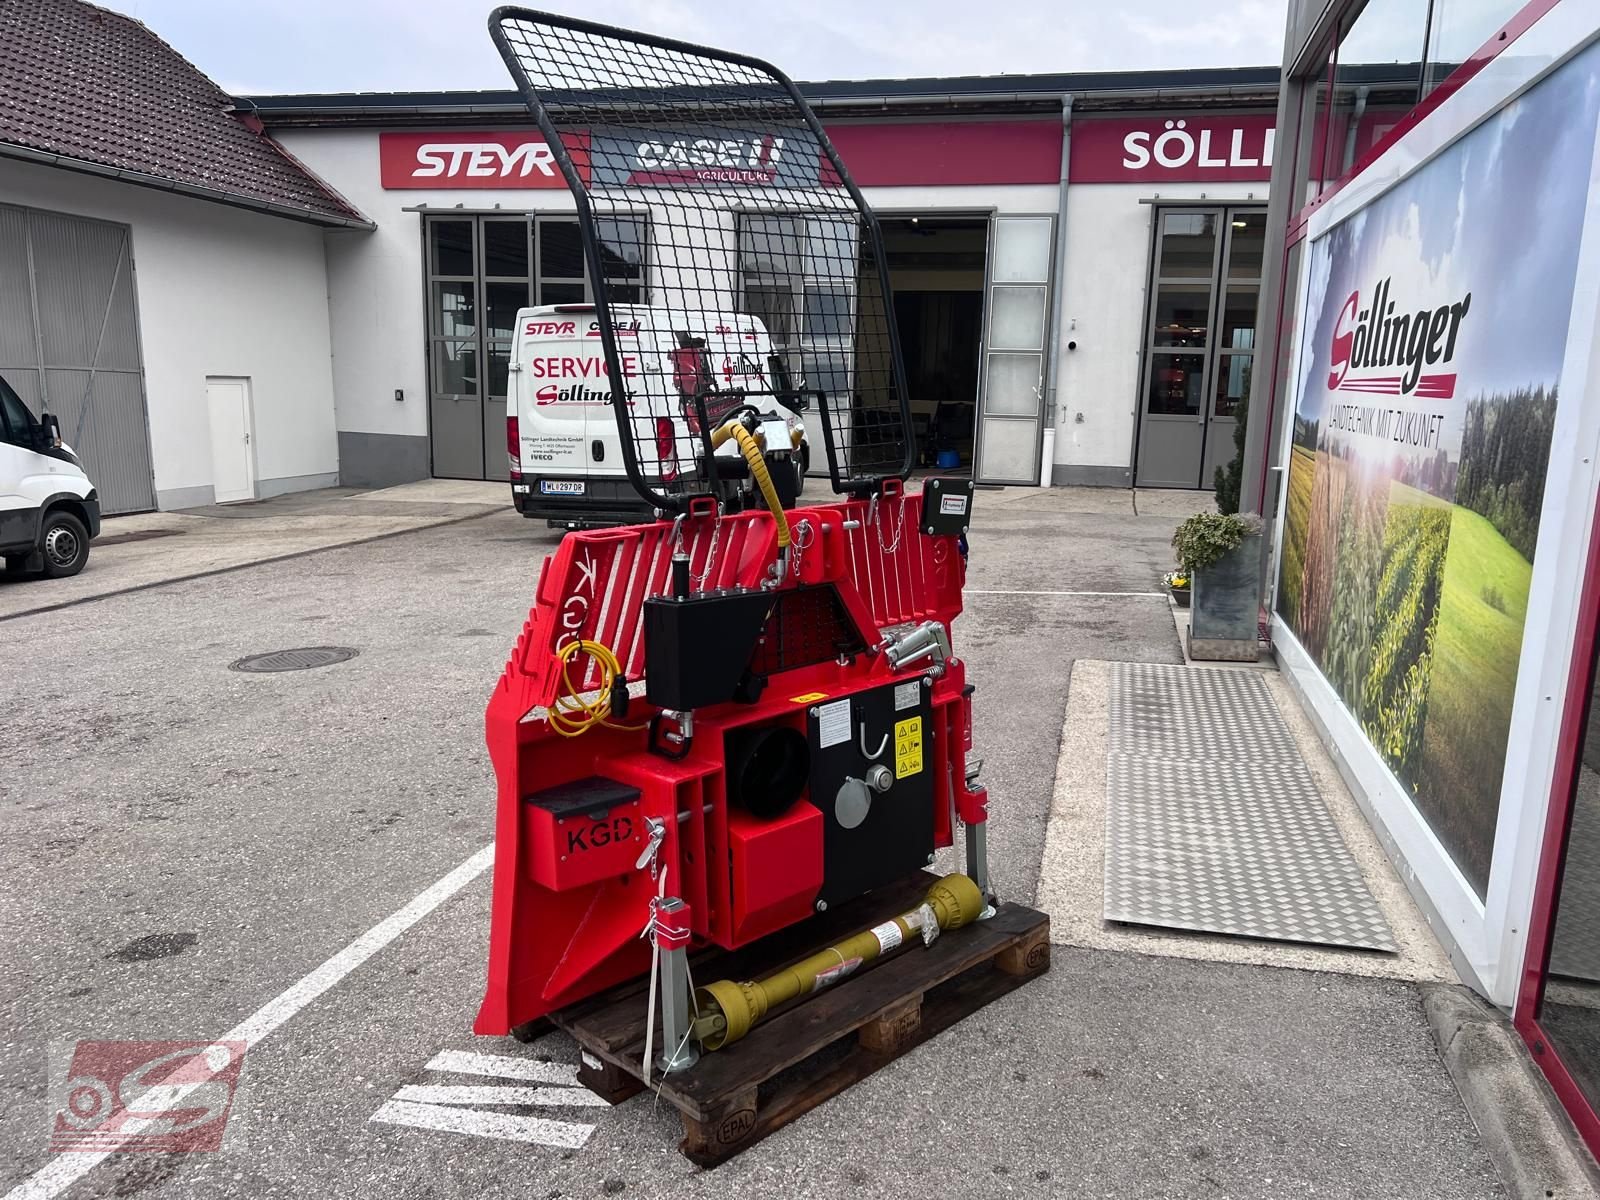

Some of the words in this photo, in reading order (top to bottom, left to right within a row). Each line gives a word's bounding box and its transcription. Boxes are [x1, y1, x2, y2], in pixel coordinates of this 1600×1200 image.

[412, 143, 555, 177] STEYR
[635, 139, 745, 168] CASE
[695, 171, 770, 182] AGRICULTURE
[525, 321, 576, 336] STEYR
[589, 321, 628, 332] CSE
[1327, 275, 1472, 395] Söllinger
[535, 384, 638, 406] Söllingr
[1329, 404, 1375, 437] LANDTECHNIK
[1375, 408, 1394, 440] MIT
[1393, 410, 1444, 450] ZUKUNFT
[567, 817, 633, 854] KGD
[722, 1113, 752, 1141] EPAL
